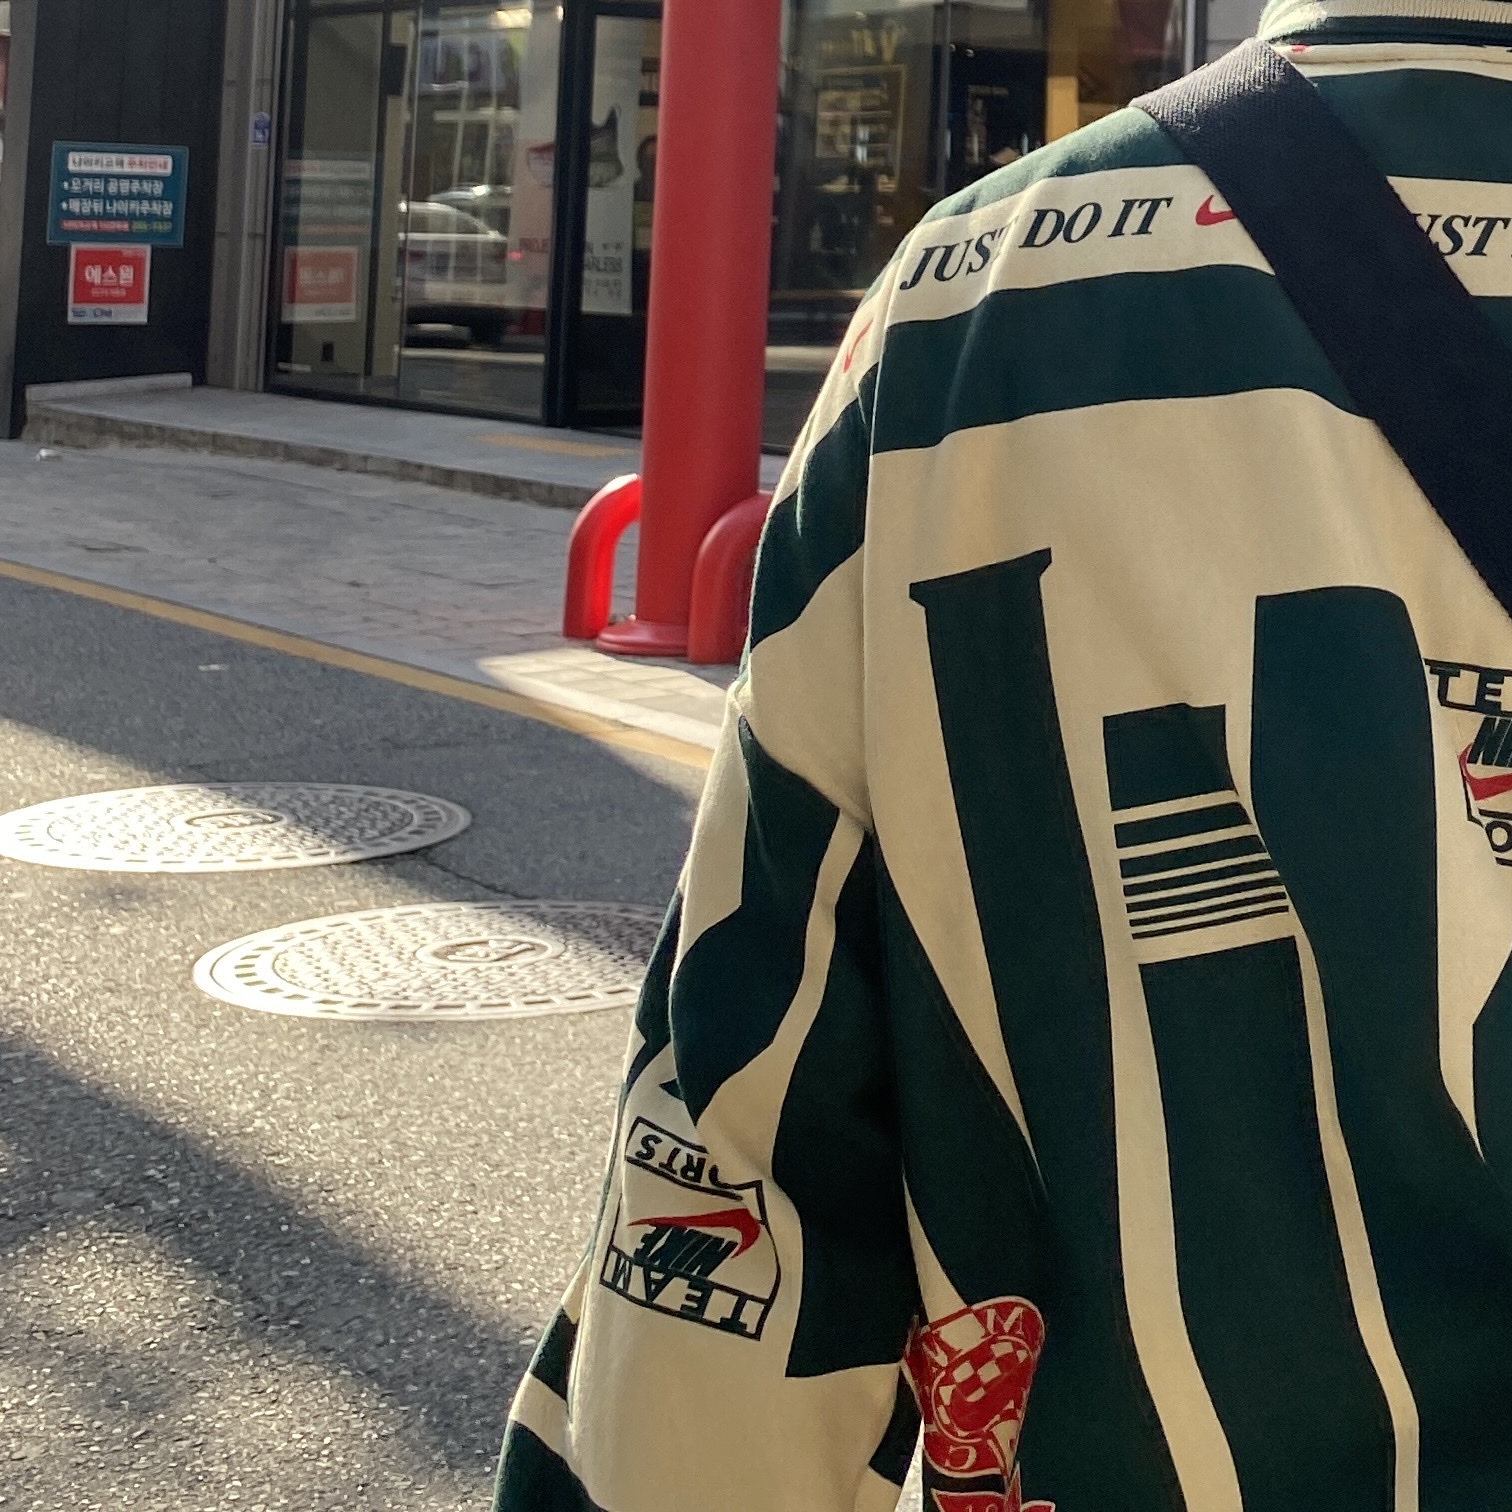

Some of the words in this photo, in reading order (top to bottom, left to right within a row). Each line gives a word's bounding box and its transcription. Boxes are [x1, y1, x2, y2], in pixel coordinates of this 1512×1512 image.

[899, 226, 1010, 290] JUS
[1018, 201, 1102, 249] DO
[1108, 196, 1174, 238] IT
[1412, 213, 1512, 257] ST
[85, 264, 135, 287] 에스원
[633, 1224, 739, 1278] NIKE
[611, 1252, 748, 1336] TEAM
